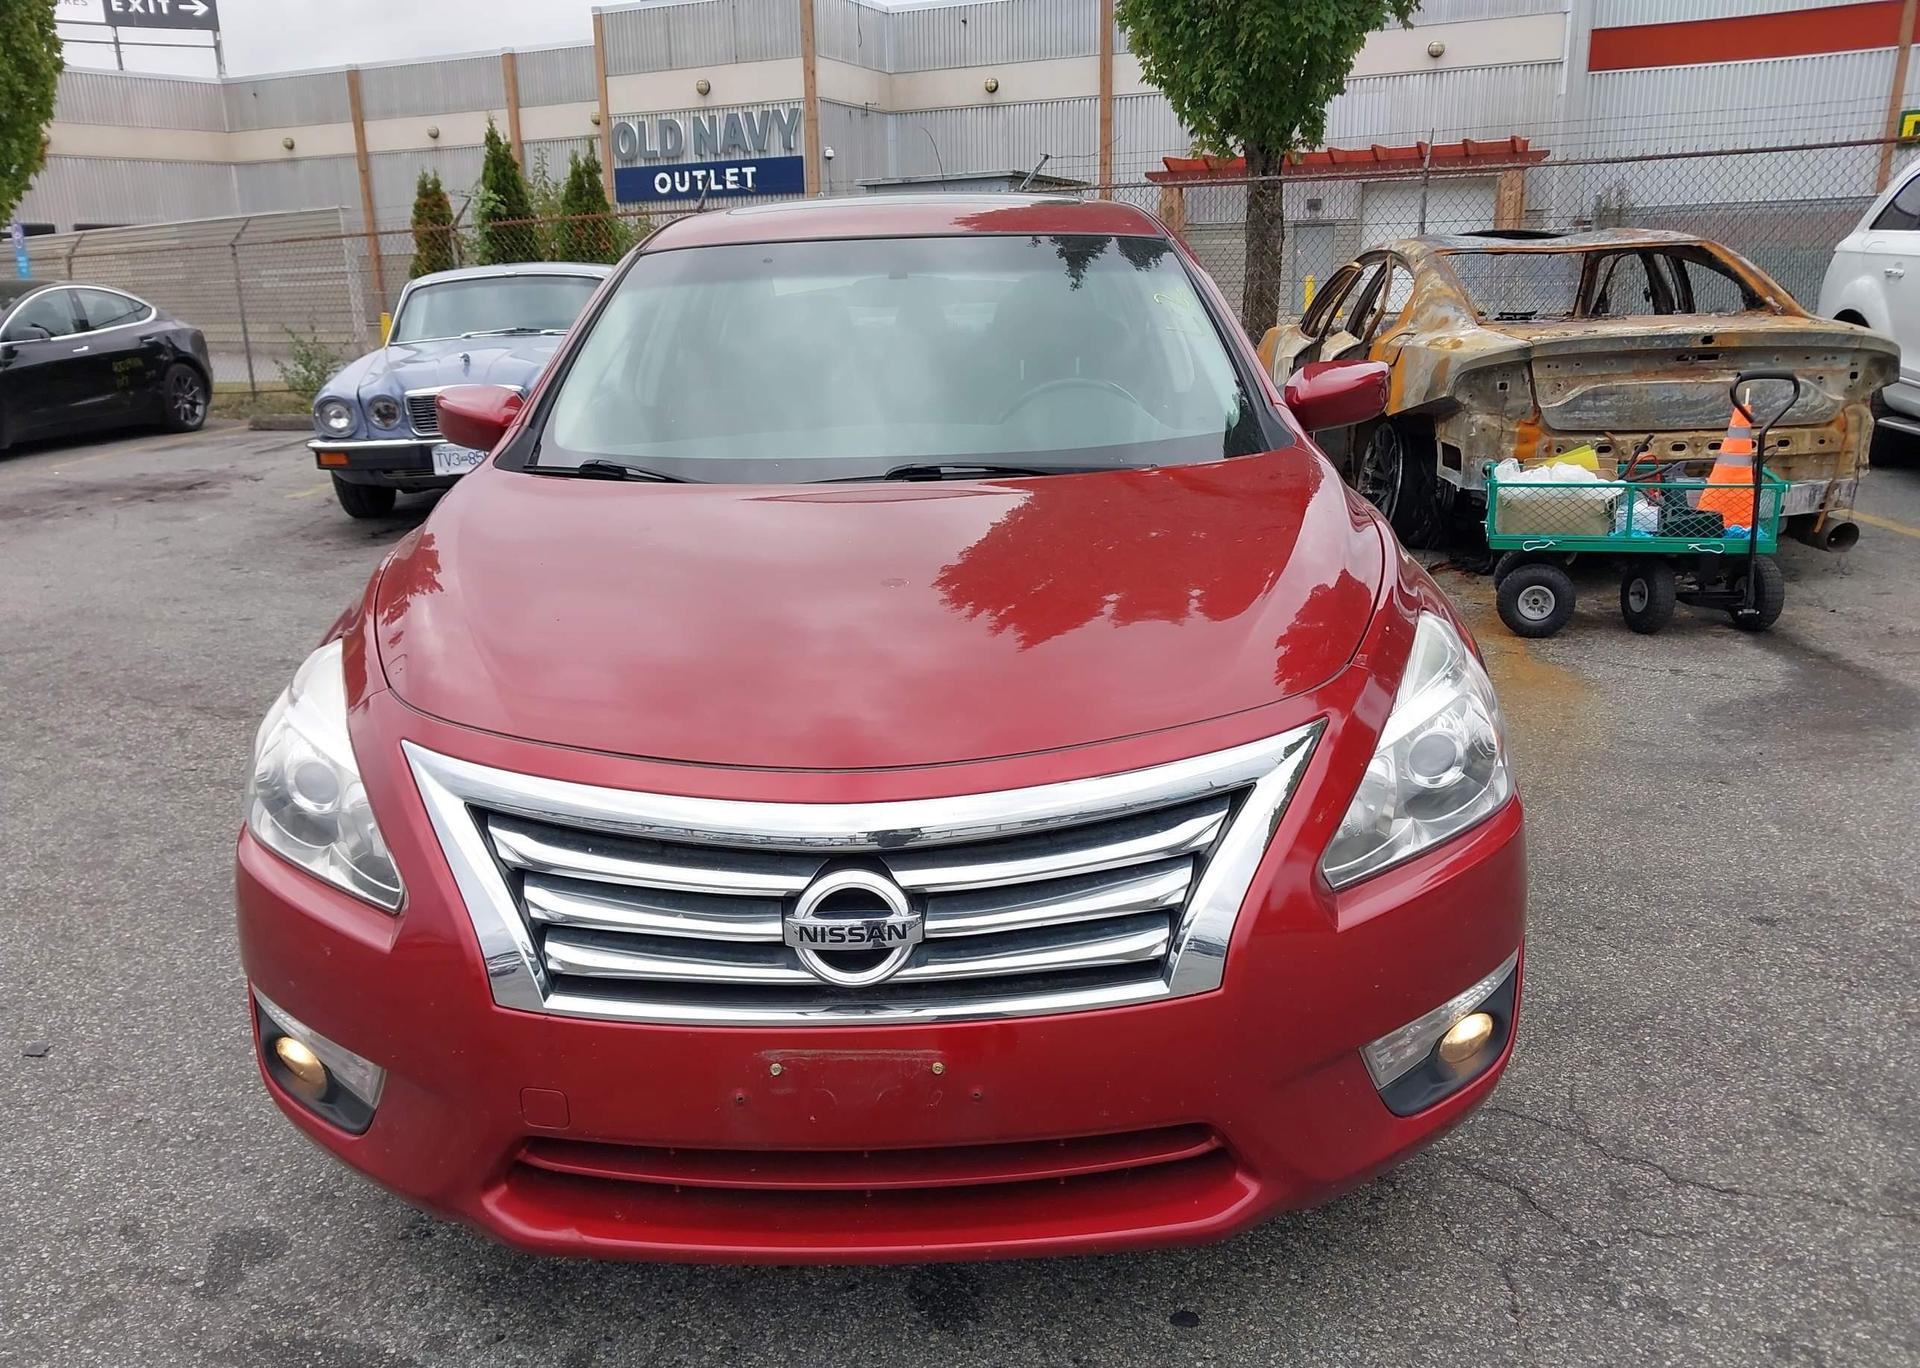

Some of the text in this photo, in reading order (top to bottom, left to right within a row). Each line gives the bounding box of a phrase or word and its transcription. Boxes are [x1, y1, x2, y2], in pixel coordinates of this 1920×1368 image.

[111, 0, 169, 14] EXIT
[612, 107, 800, 161] OLD NAVY
[654, 166, 757, 194] OUTLET
[799, 923, 907, 943] NISSAN
